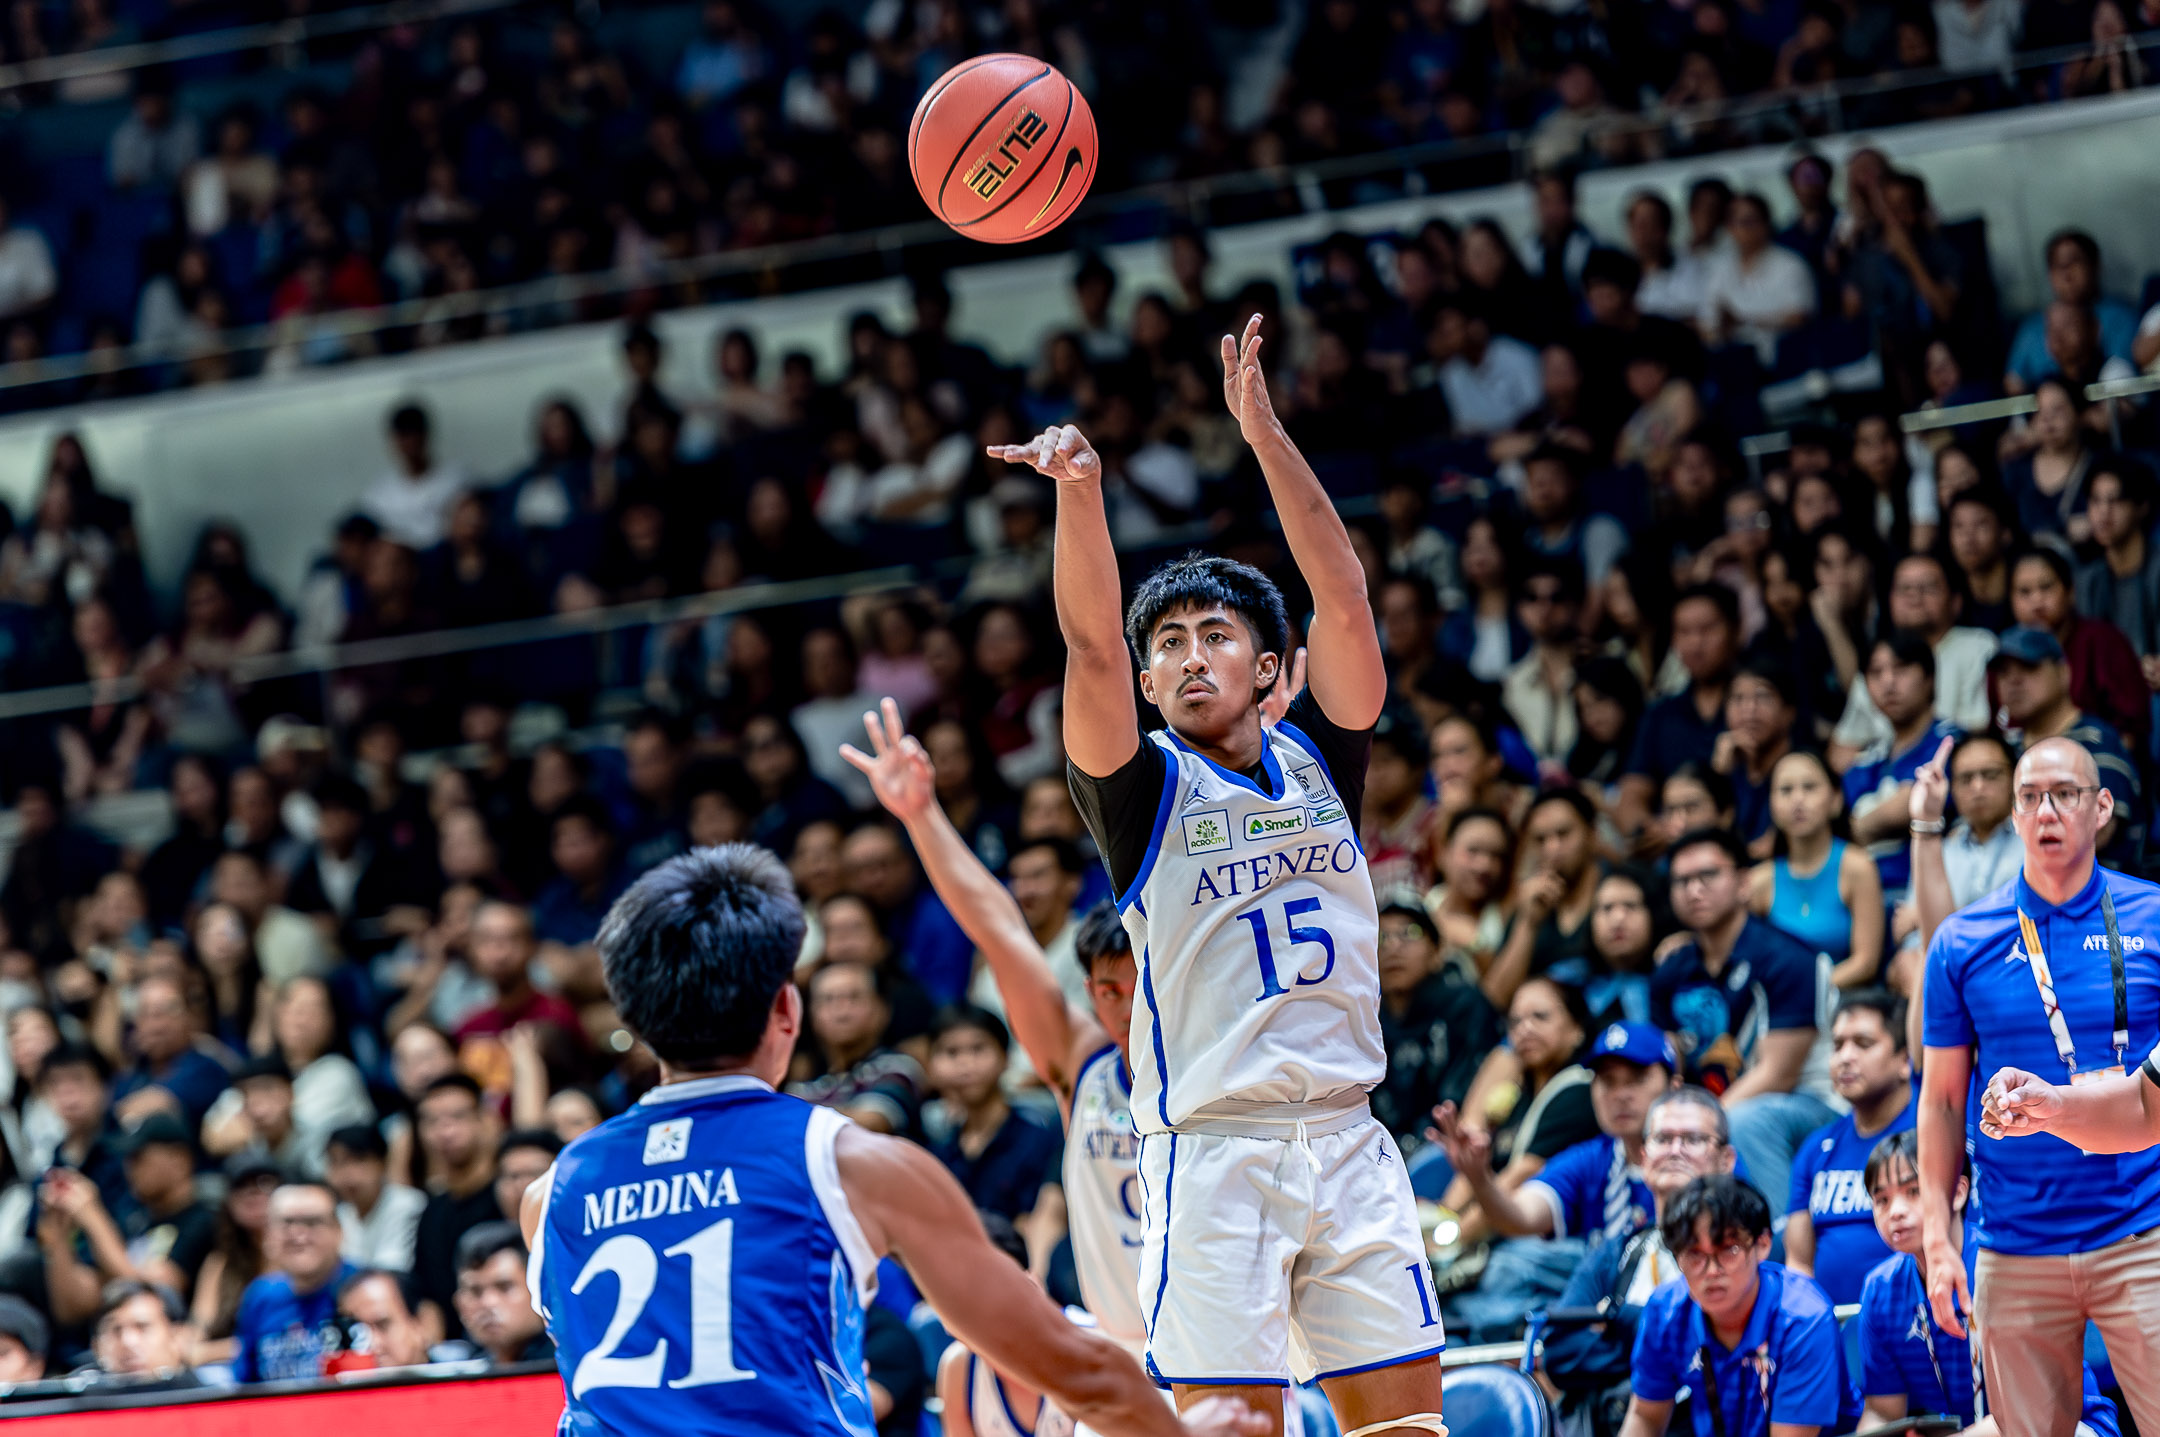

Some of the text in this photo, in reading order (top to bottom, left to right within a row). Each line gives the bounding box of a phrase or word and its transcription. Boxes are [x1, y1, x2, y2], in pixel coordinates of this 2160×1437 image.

[966, 109, 1049, 203] ELITE
[1190, 836, 1227, 849] ACROCITY
[1264, 815, 1303, 832] Smart
[1190, 838, 1357, 906] ATENEO
[1236, 896, 1336, 1002] 15
[2082, 934, 2145, 952] ATEEO
[582, 1167, 742, 1236] MEDINA
[570, 1217, 758, 1402] 21
[1405, 1262, 1440, 1329] 1
